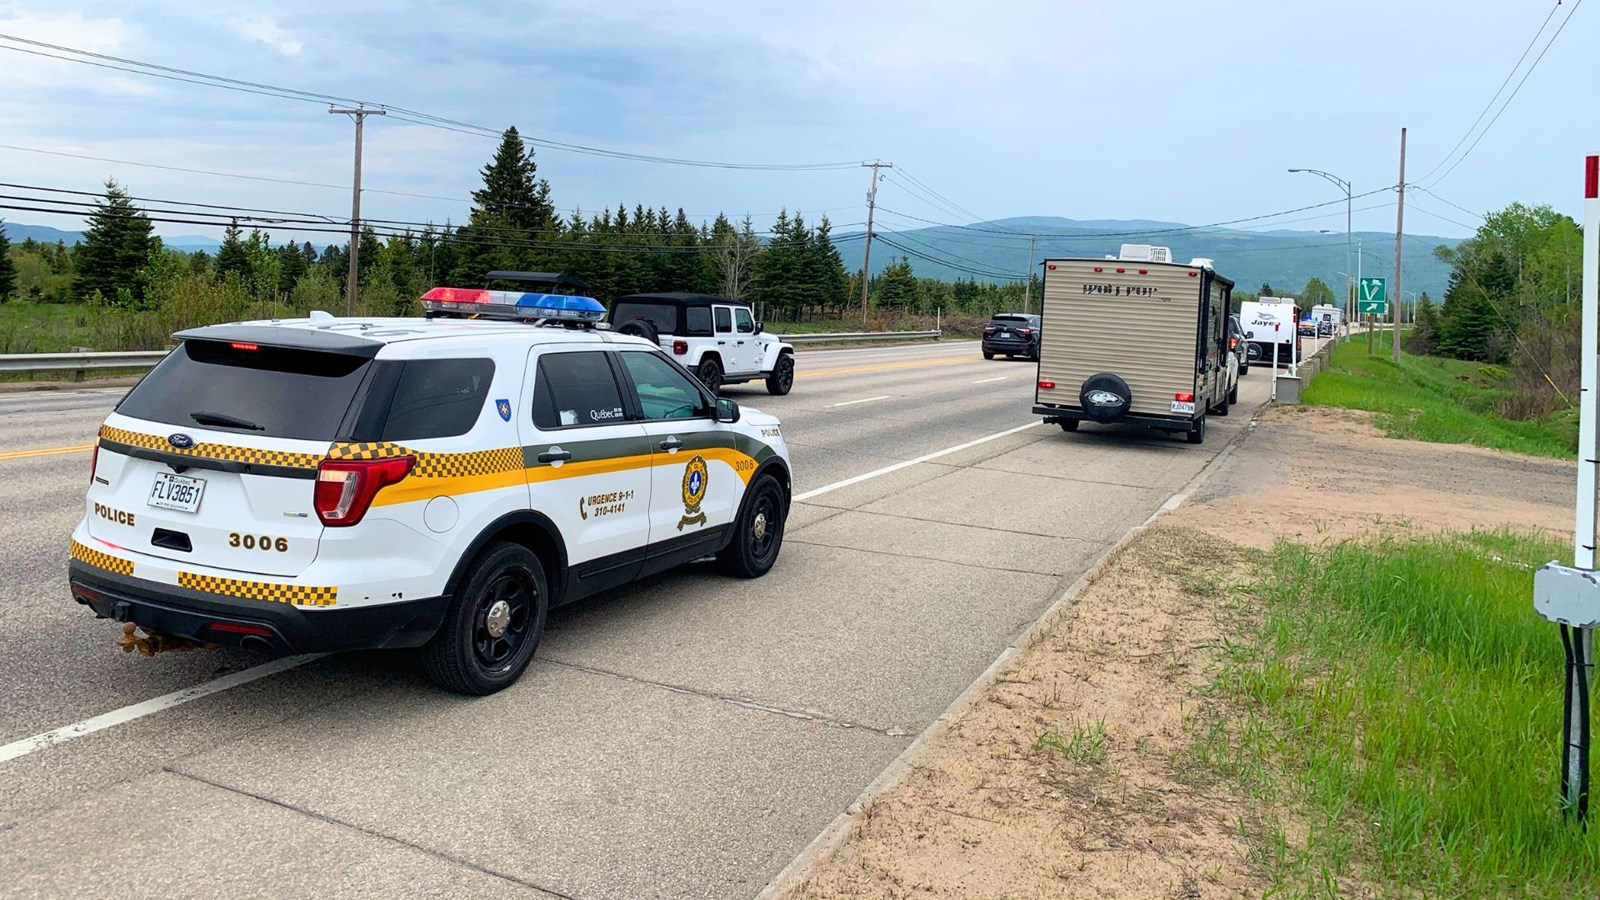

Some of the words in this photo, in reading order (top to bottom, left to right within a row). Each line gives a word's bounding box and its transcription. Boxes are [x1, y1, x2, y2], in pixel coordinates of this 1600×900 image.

[590, 407, 614, 420] Québec
[761, 428, 780, 437] POLICE
[736, 460, 754, 471] 3006
[152, 480, 201, 505] FLV3851
[588, 492, 617, 506] URGENCE
[618, 490, 634, 501] 9-1-1
[95, 502, 135, 527] POLICE
[594, 503, 625, 517] 310-4141
[229, 532, 288, 552] 3006
